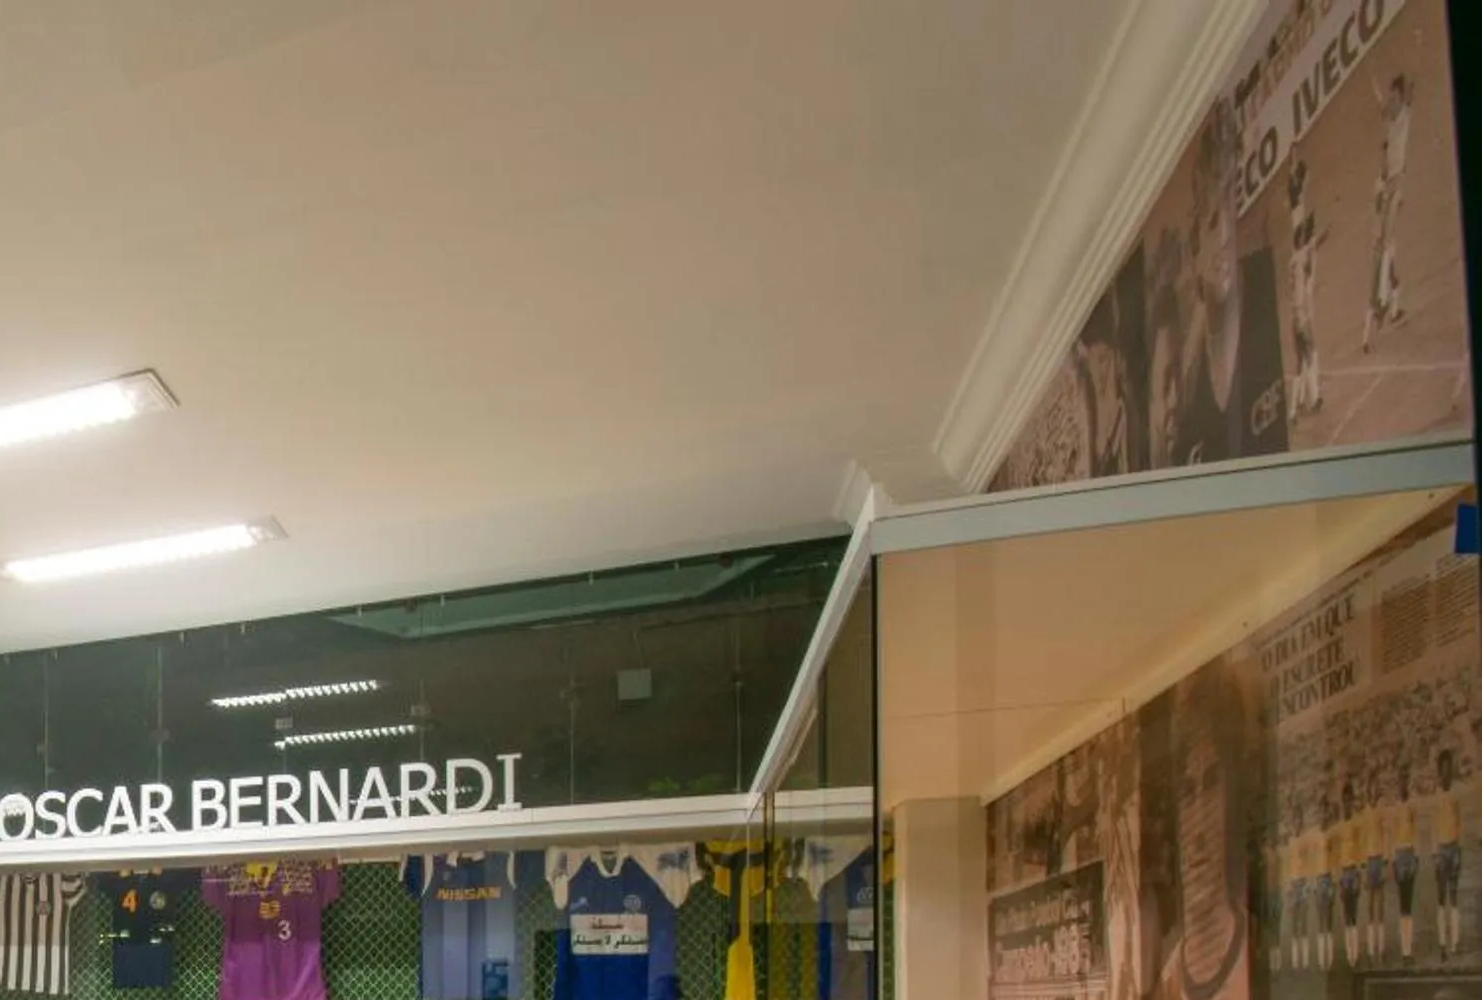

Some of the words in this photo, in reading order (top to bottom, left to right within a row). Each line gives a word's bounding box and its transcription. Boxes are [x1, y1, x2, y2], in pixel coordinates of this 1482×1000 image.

[1292, 0, 1386, 137] IVECO
[191, 753, 523, 832] BERNARDI
[122, 888, 139, 913] 4
[437, 886, 502, 901] NISSAN
[278, 920, 291, 941] 3
